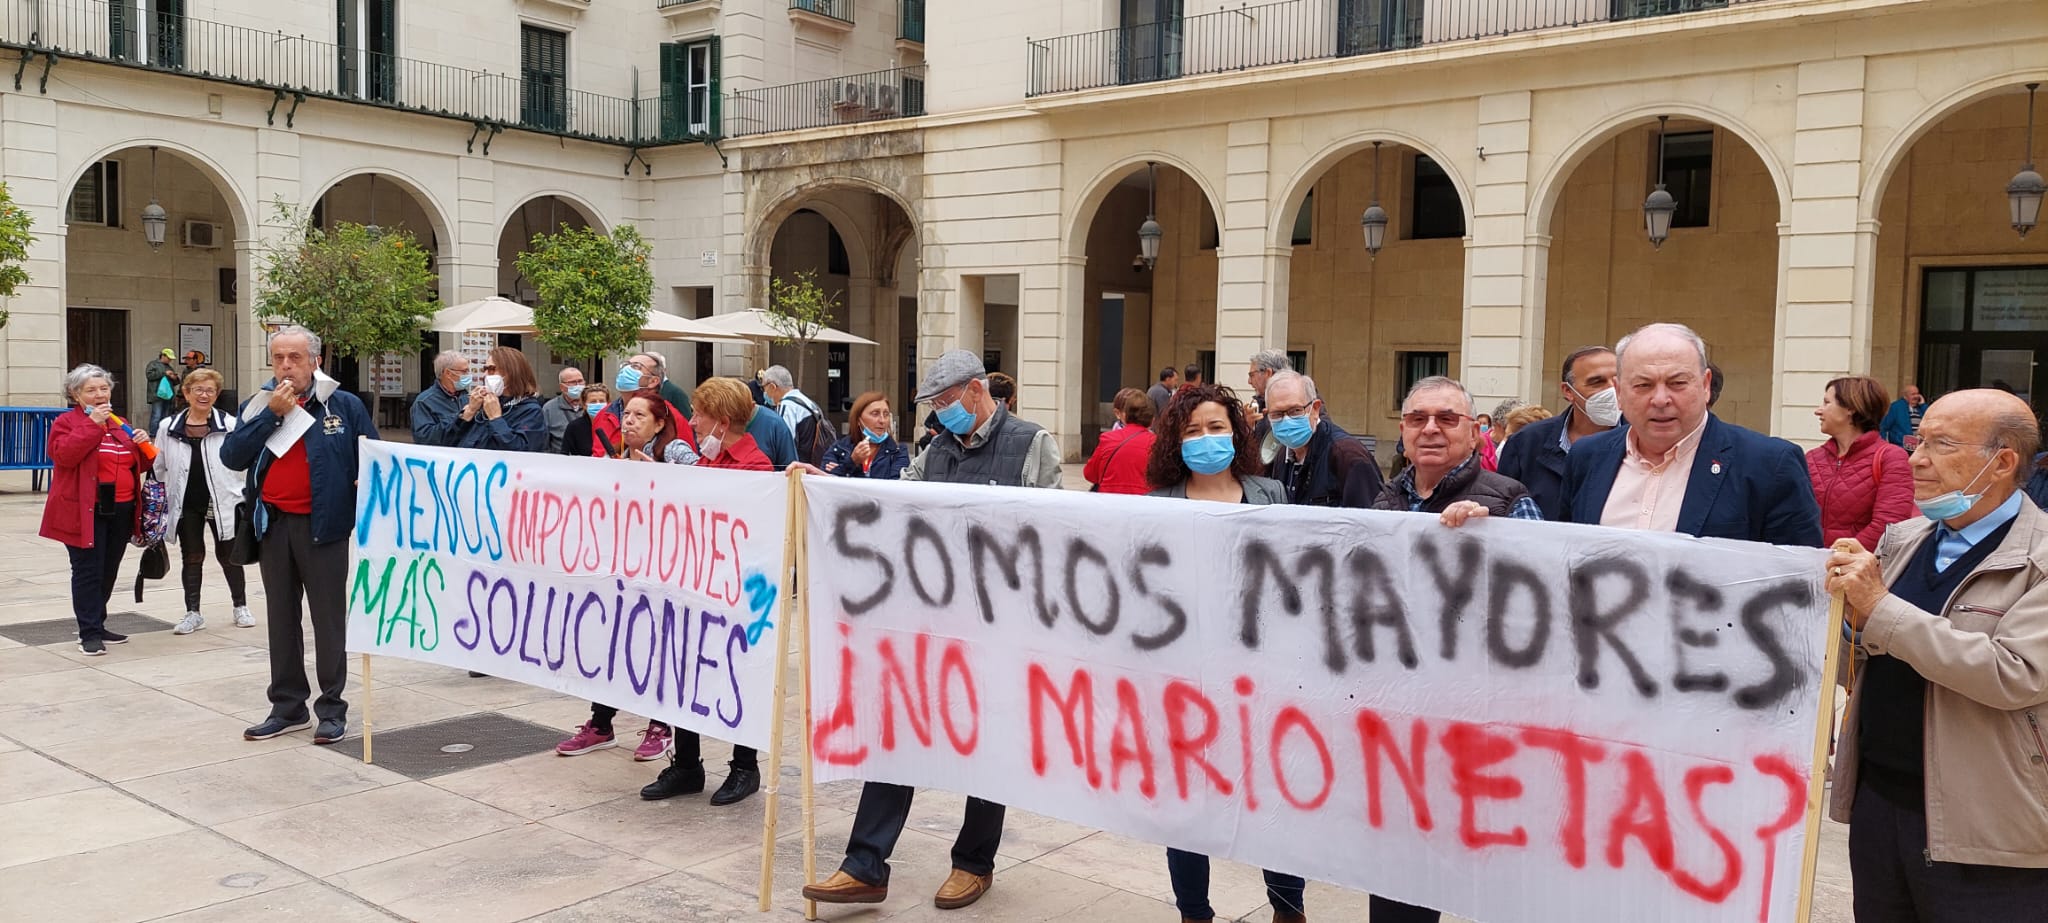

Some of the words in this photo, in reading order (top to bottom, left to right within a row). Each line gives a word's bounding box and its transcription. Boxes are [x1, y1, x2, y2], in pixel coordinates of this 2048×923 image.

[356, 455, 508, 561] MENOS
[349, 552, 445, 652] MÁS
[832, 499, 1188, 651] SOMOS
[1240, 531, 1817, 709] MAYORES
[813, 621, 980, 766] ¿NO
